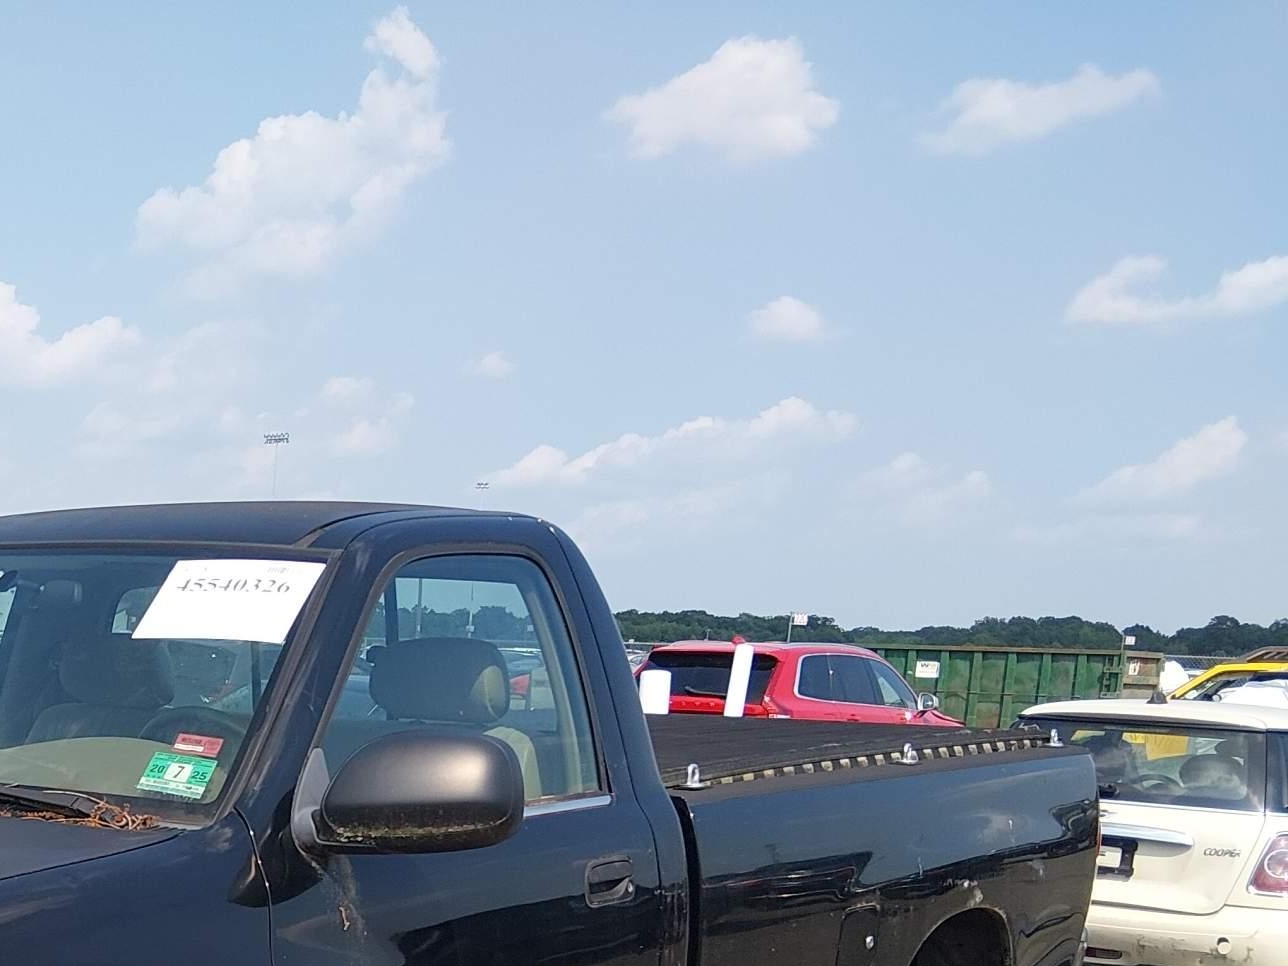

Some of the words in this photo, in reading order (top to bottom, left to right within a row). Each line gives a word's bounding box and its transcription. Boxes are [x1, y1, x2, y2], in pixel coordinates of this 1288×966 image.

[176, 577, 291, 593] 45540326
[149, 764, 166, 774] 20
[173, 765, 186, 779] 7
[191, 770, 209, 781] 25
